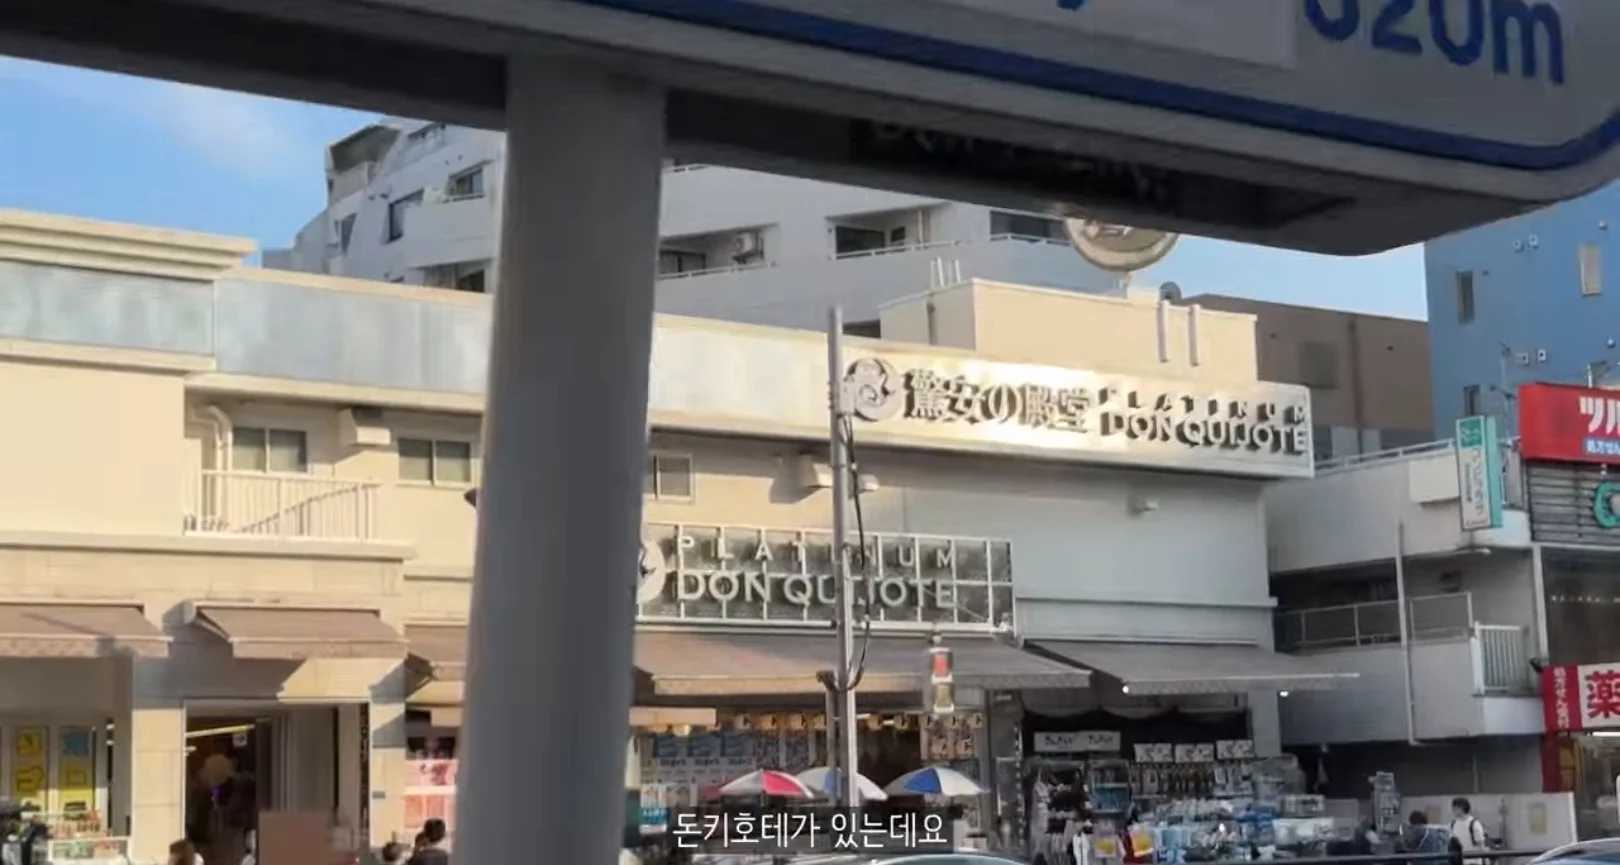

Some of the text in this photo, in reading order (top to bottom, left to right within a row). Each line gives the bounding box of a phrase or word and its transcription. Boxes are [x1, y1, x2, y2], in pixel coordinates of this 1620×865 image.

[1100, 387, 1306, 425] PLATINUM
[1101, 411, 1309, 455] DON QUIJOTE
[677, 570, 772, 602] DON
